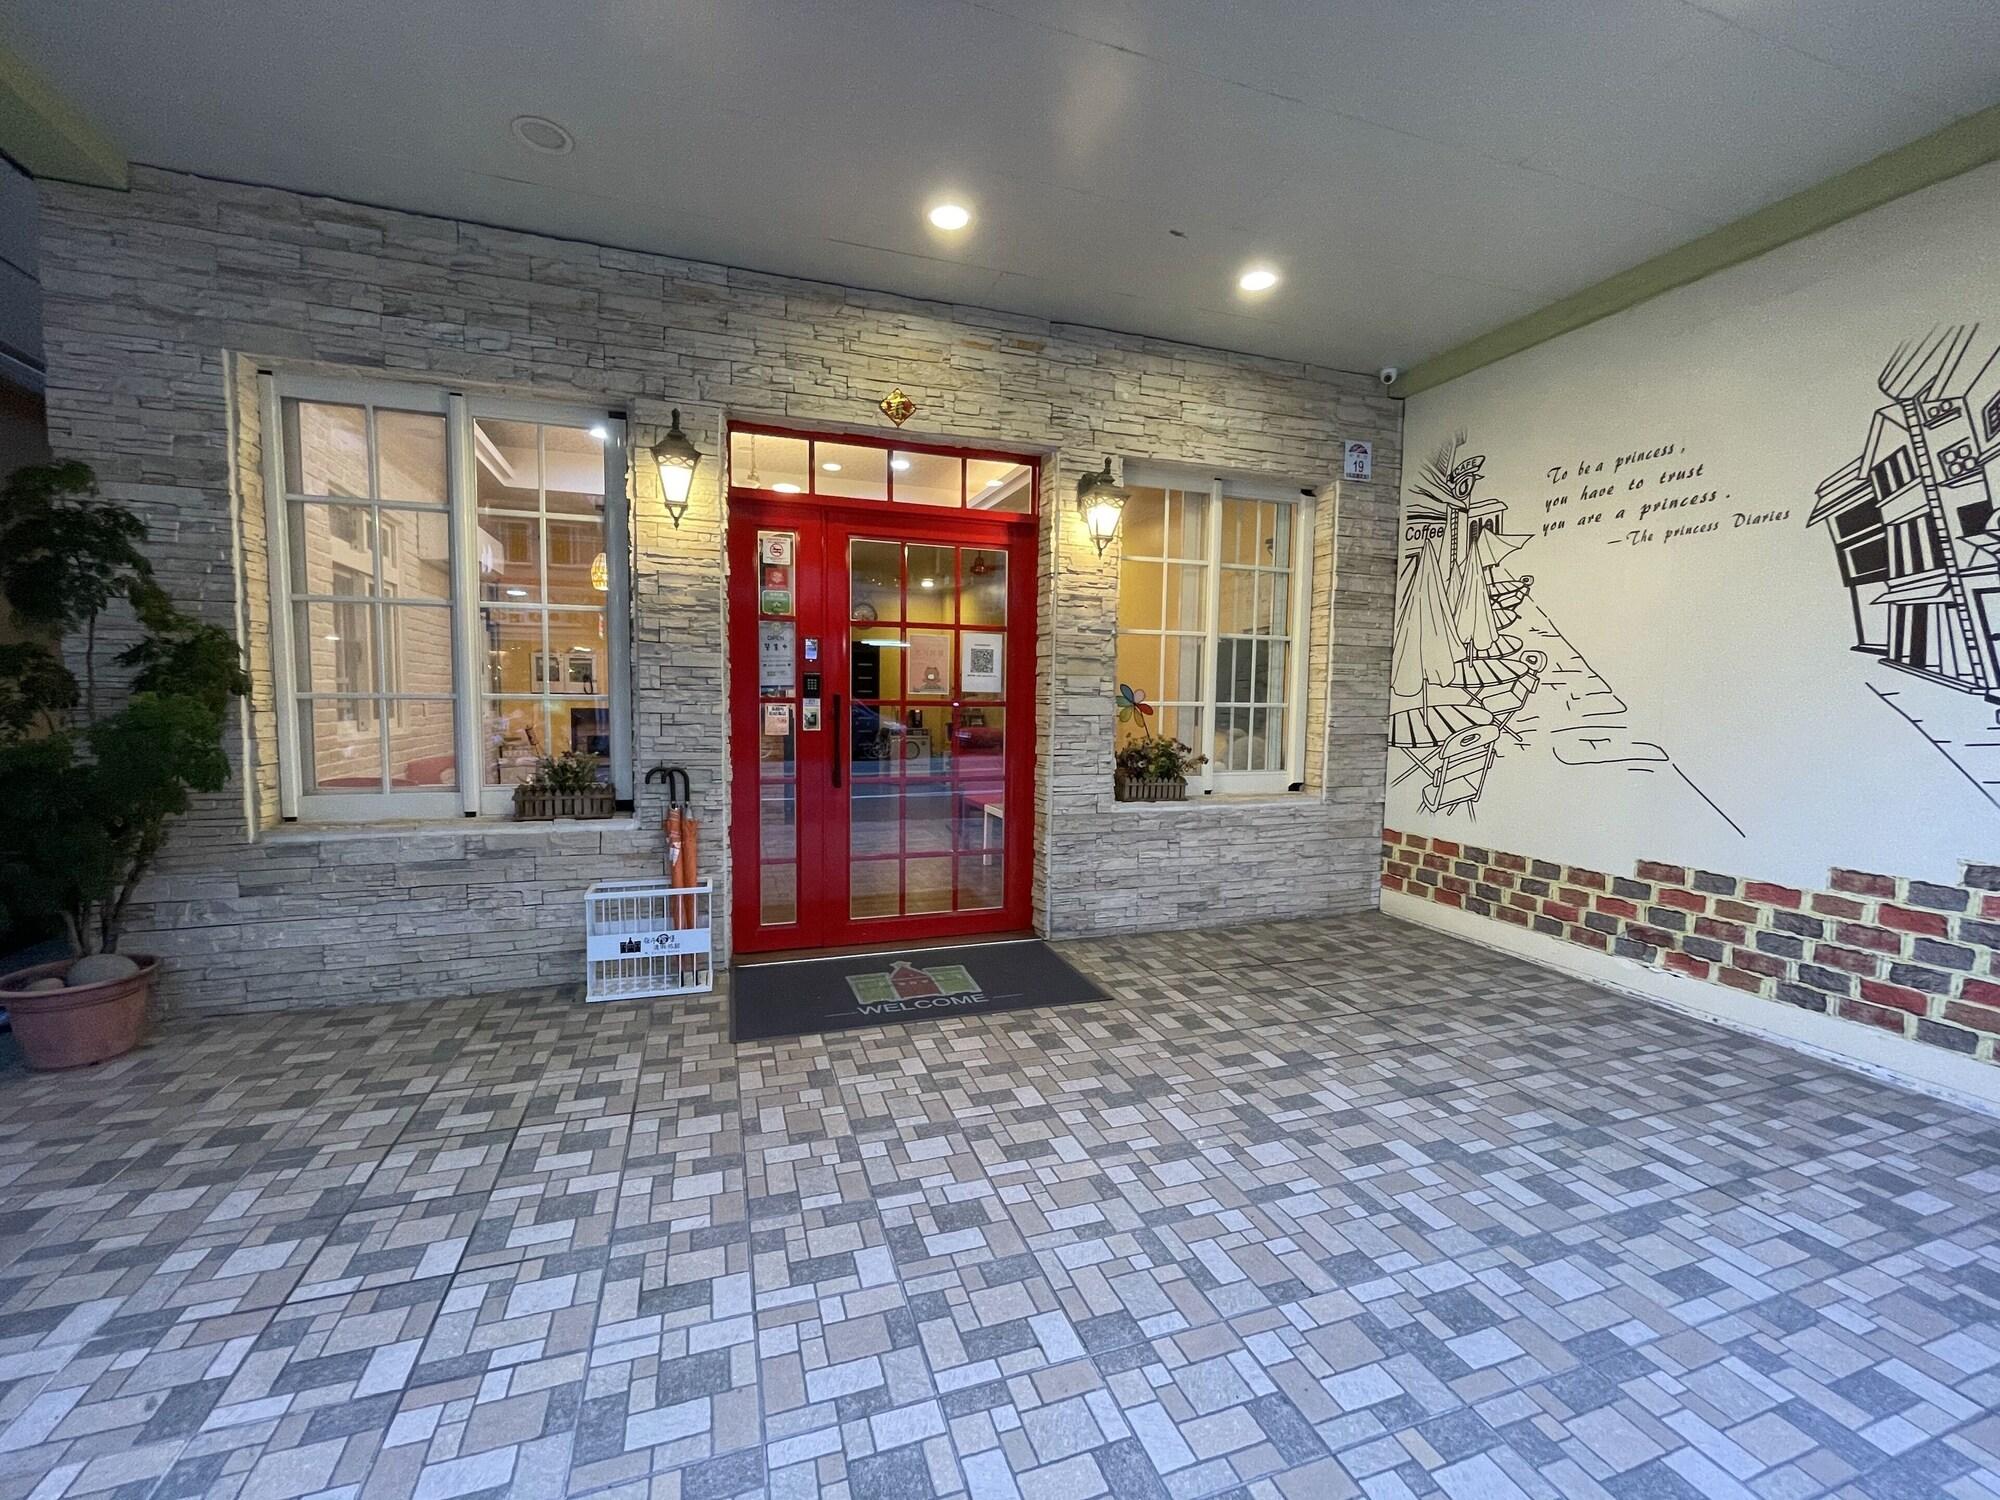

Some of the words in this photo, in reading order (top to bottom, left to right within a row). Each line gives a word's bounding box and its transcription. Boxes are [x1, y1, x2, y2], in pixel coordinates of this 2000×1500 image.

[1353, 460, 1364, 473] 19
[1546, 466, 1568, 484] To
[1578, 460, 1591, 476] be
[1595, 462, 1604, 472] a
[1545, 495, 1568, 513] you
[1580, 485, 1614, 501] have
[1628, 478, 1644, 490] to
[1659, 463, 1704, 484] trust
[1405, 524, 1444, 541] Coffee
[1542, 520, 1565, 537] you
[1577, 513, 1602, 525] are
[1615, 509, 1625, 519] a
[1663, 521, 1720, 544] princess
[1732, 510, 1791, 528] Diaries
[856, 993, 990, 1016] WELCOME
